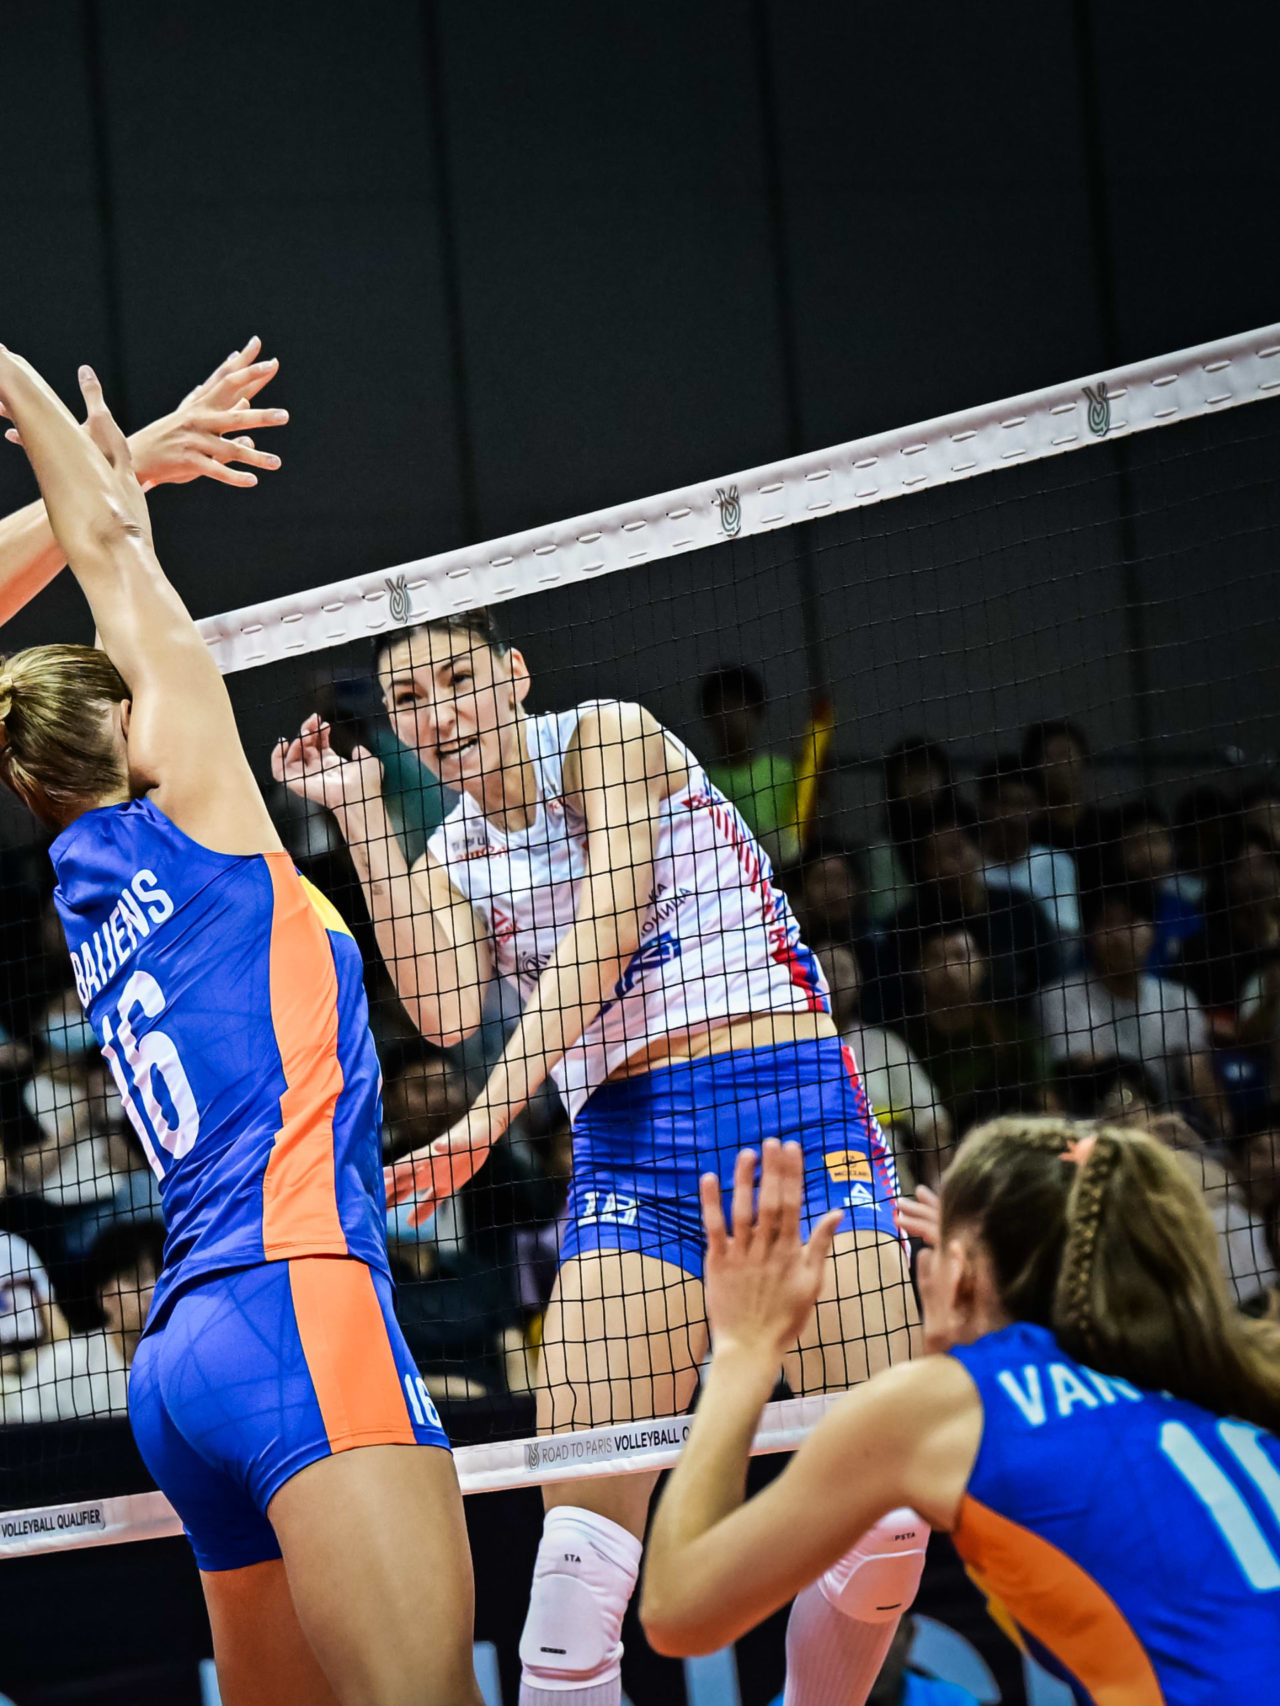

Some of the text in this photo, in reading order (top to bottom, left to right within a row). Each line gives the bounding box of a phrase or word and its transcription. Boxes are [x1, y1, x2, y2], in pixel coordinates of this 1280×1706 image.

[101, 969, 201, 1183] 16
[404, 1373, 443, 1428] 16
[542, 1444, 569, 1463] ROAD
[571, 1443, 584, 1458] TO
[586, 1437, 612, 1457] PARIS
[613, 1426, 680, 1452] VOLLEYBALL
[1, 1517, 56, 1539] VOLLEYBALL
[56, 1508, 102, 1530] QUALIFIER
